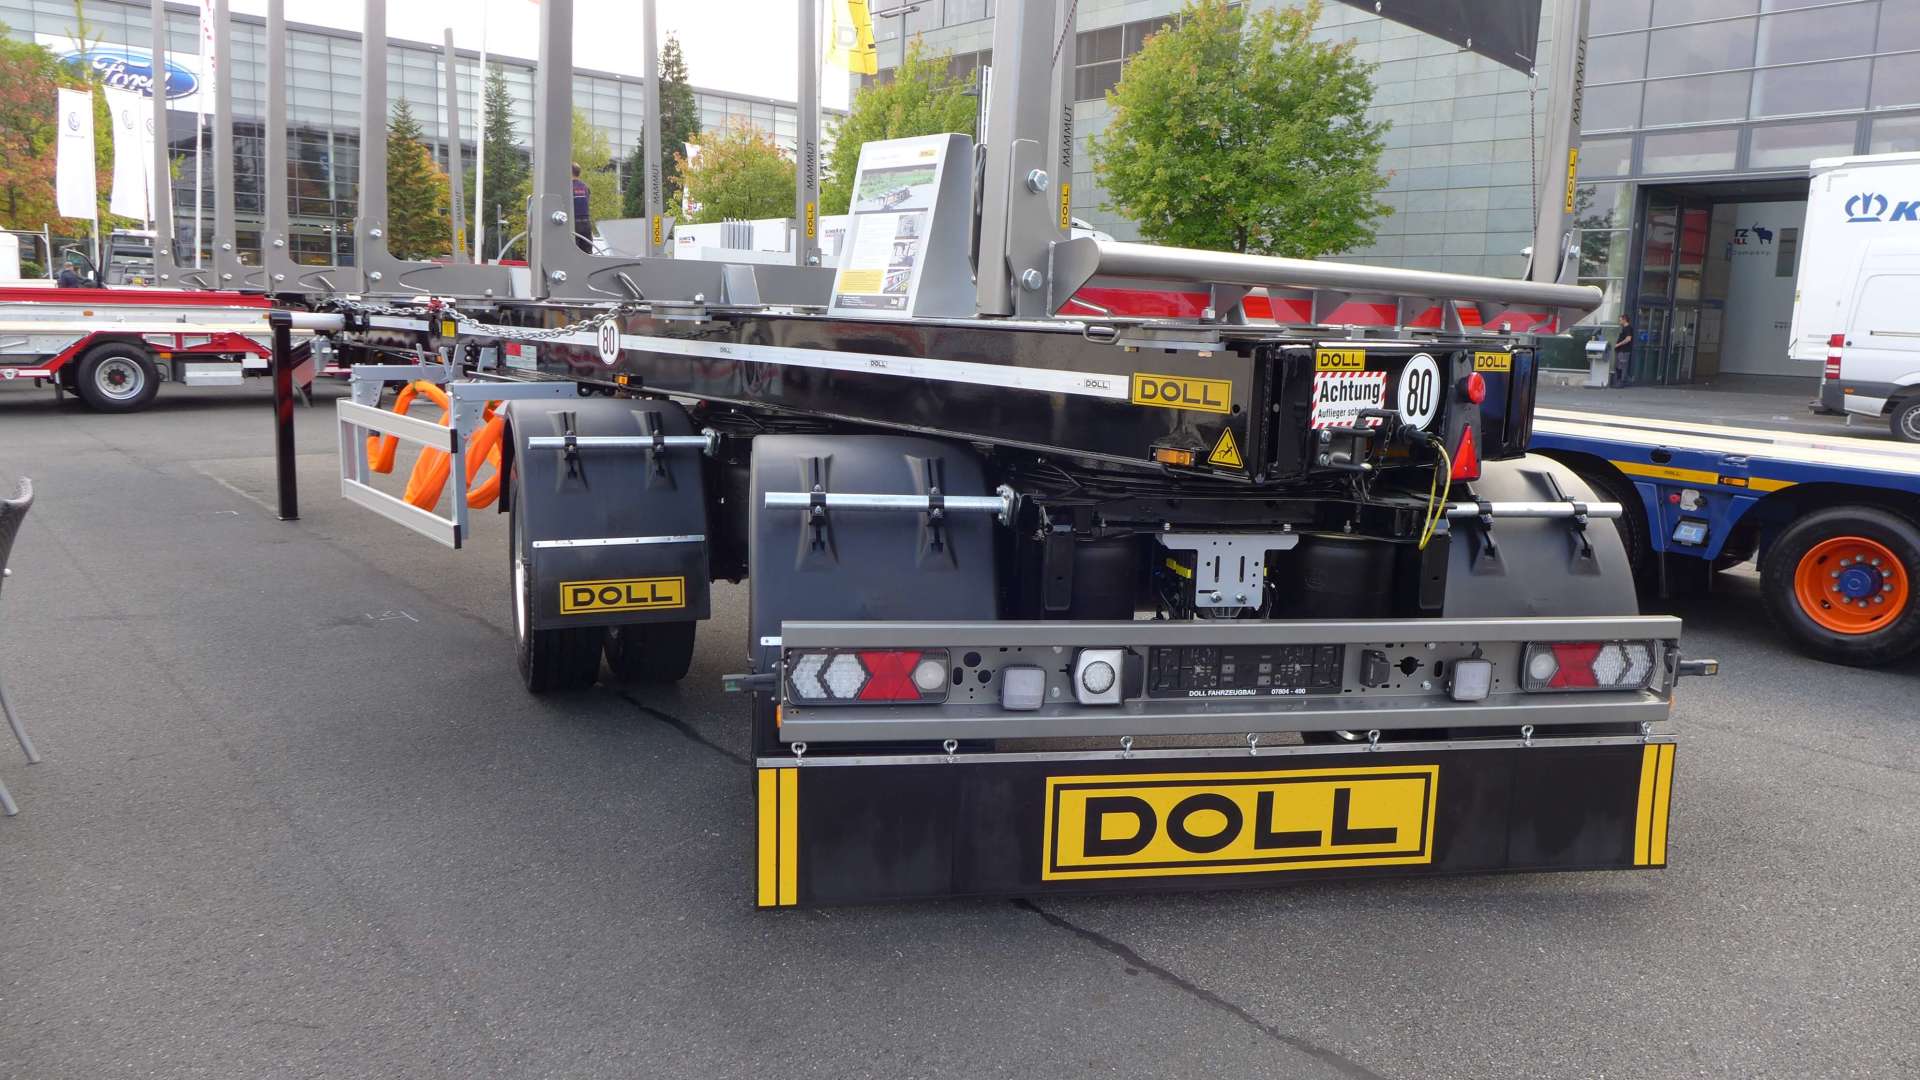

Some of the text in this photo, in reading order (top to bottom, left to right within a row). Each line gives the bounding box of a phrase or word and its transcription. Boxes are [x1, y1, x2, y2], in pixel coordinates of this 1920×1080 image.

[1573, 39, 1588, 126] MAMMUT
[1063, 104, 1072, 168] MAMMUT
[807, 140, 816, 190] MAMMUT
[1568, 155, 1576, 208] DOLL
[1889, 201, 1920, 221] K
[602, 327, 615, 355] 80
[1320, 353, 1361, 367] DOLL
[1477, 355, 1508, 368] DOLL
[1085, 380, 1108, 389] DOLL
[1140, 379, 1222, 407] DOLL
[1319, 380, 1381, 404] Achtung
[1406, 368, 1433, 417] 80
[1318, 408, 1346, 419] Auflieger
[572, 583, 673, 607] DOLL
[1083, 787, 1398, 858] DOLL
